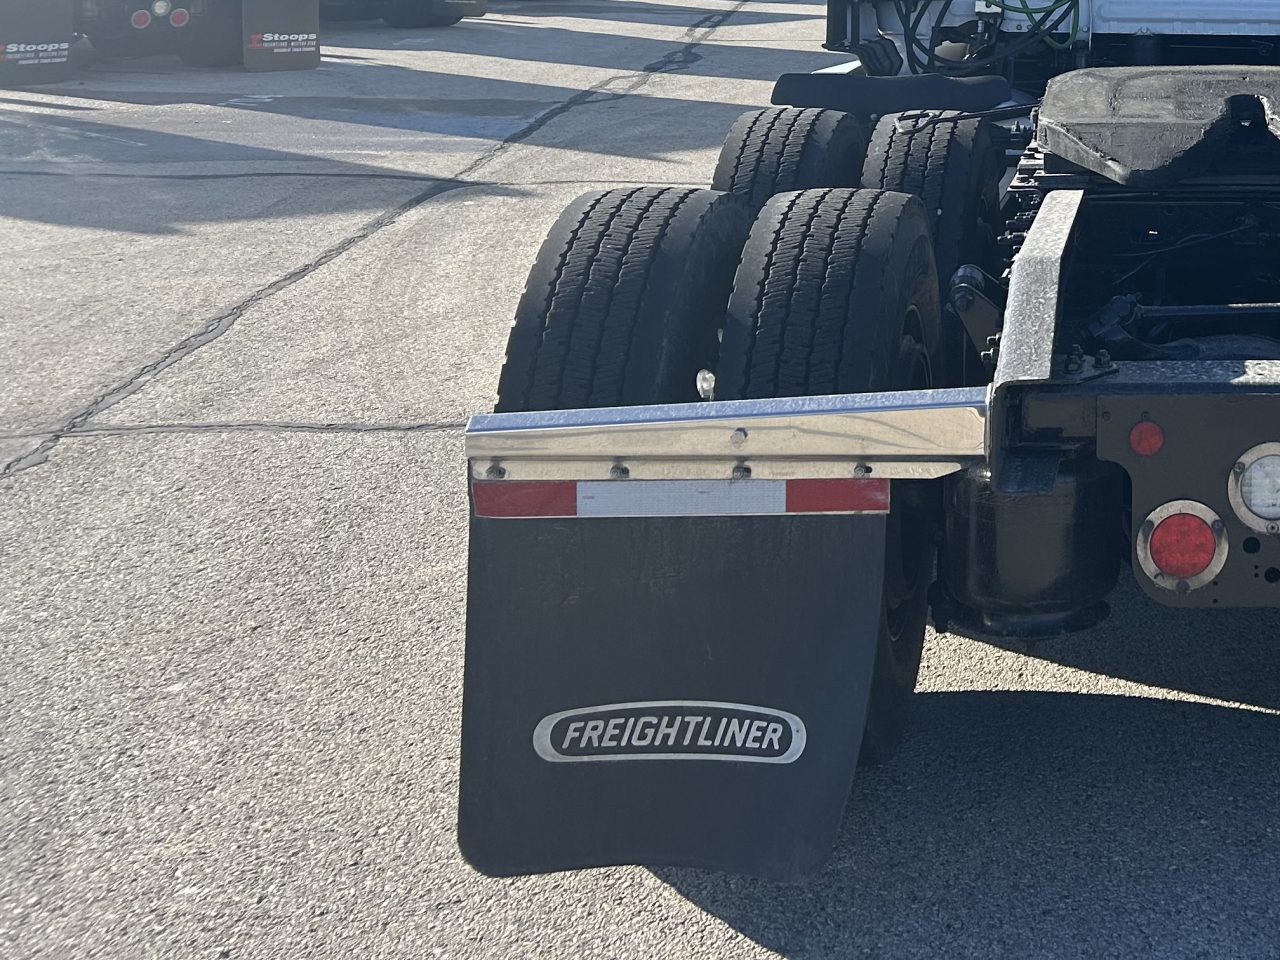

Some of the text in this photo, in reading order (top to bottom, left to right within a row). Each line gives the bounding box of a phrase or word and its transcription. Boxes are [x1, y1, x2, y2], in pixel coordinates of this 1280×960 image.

[263, 33, 317, 41] Stoops
[5, 42, 70, 52] Stoops
[562, 715, 783, 751] FREIGHTLINER
